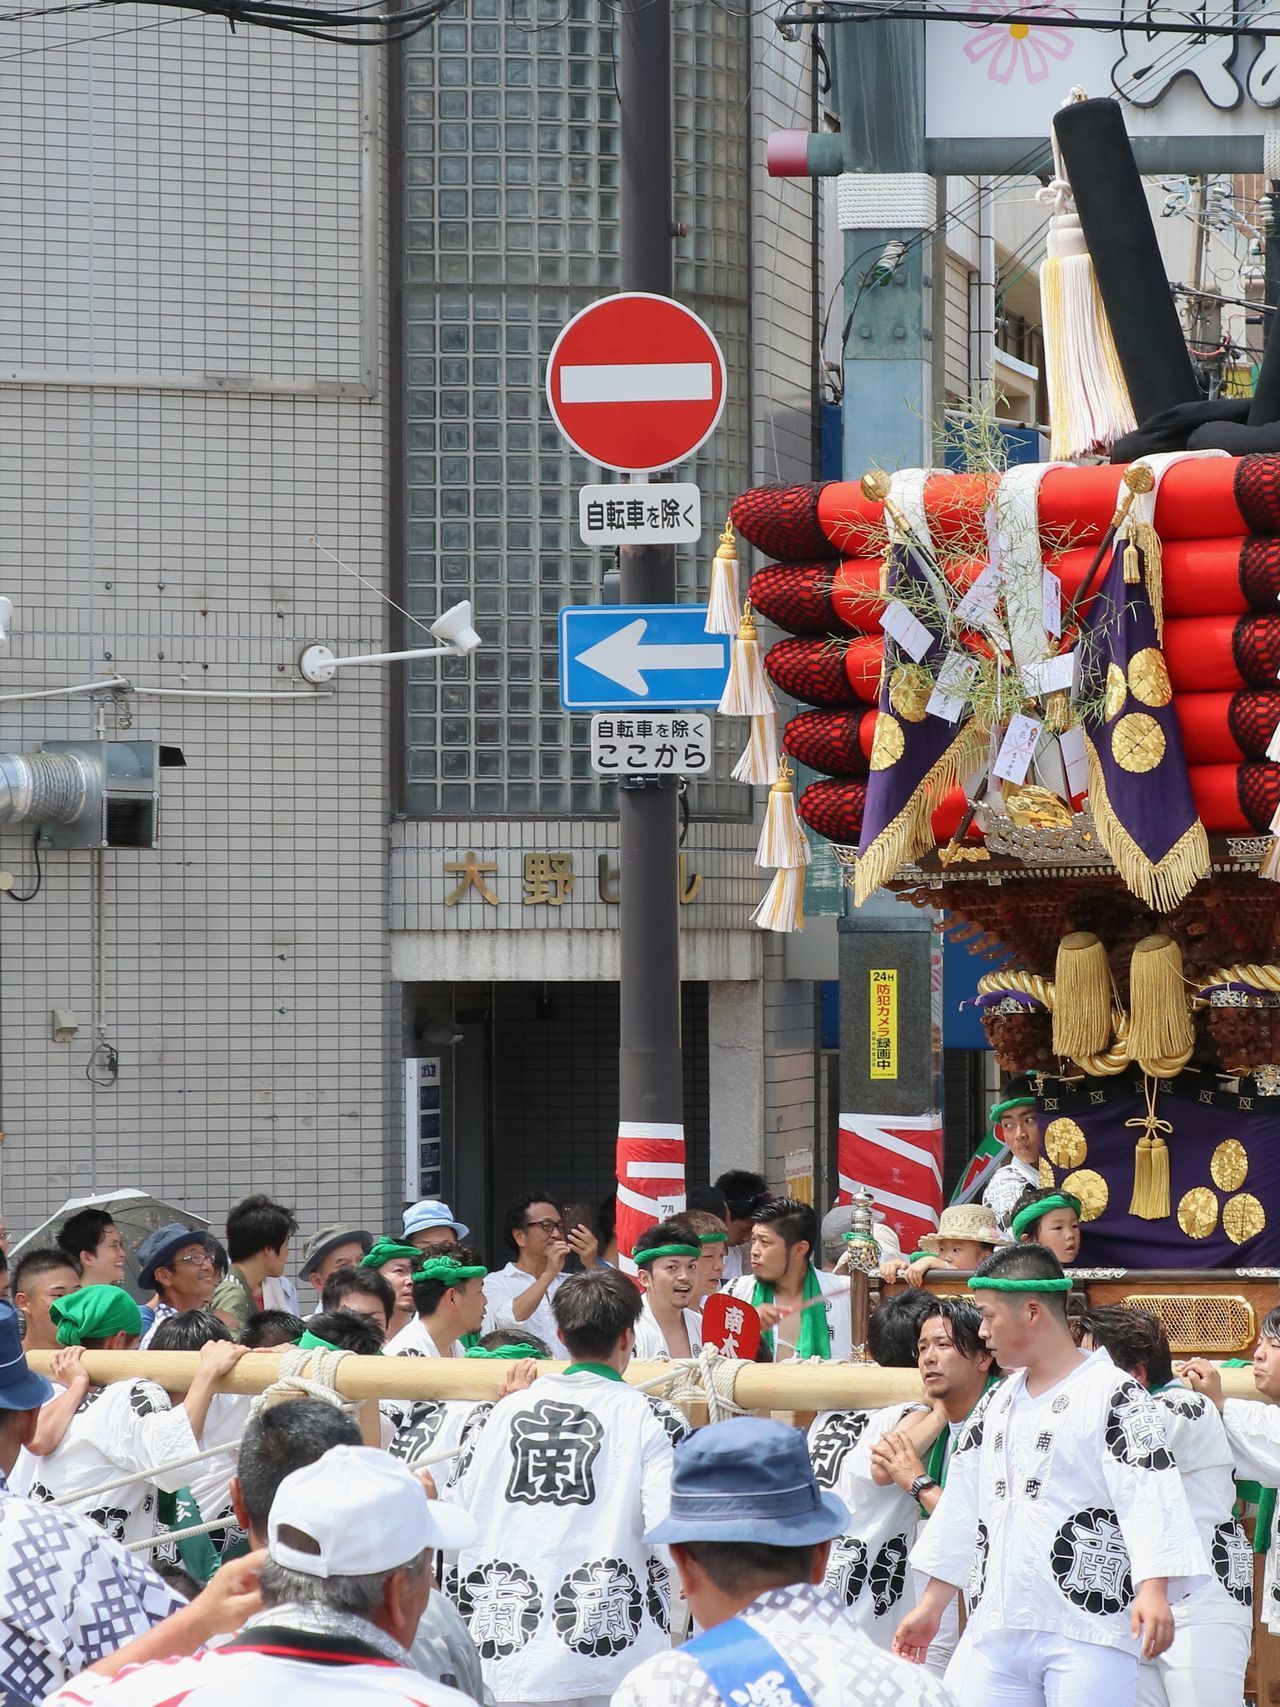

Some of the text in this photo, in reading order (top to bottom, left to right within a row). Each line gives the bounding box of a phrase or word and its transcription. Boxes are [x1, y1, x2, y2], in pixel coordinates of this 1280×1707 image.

[586, 498, 695, 532] 自転車を除く
[598, 720, 705, 740] 自転車を除く
[597, 743, 706, 770] ここから
[873, 971, 894, 981] 24H
[876, 983, 891, 1070] 防犯カメラ録画中
[504, 1400, 605, 1507] 南
